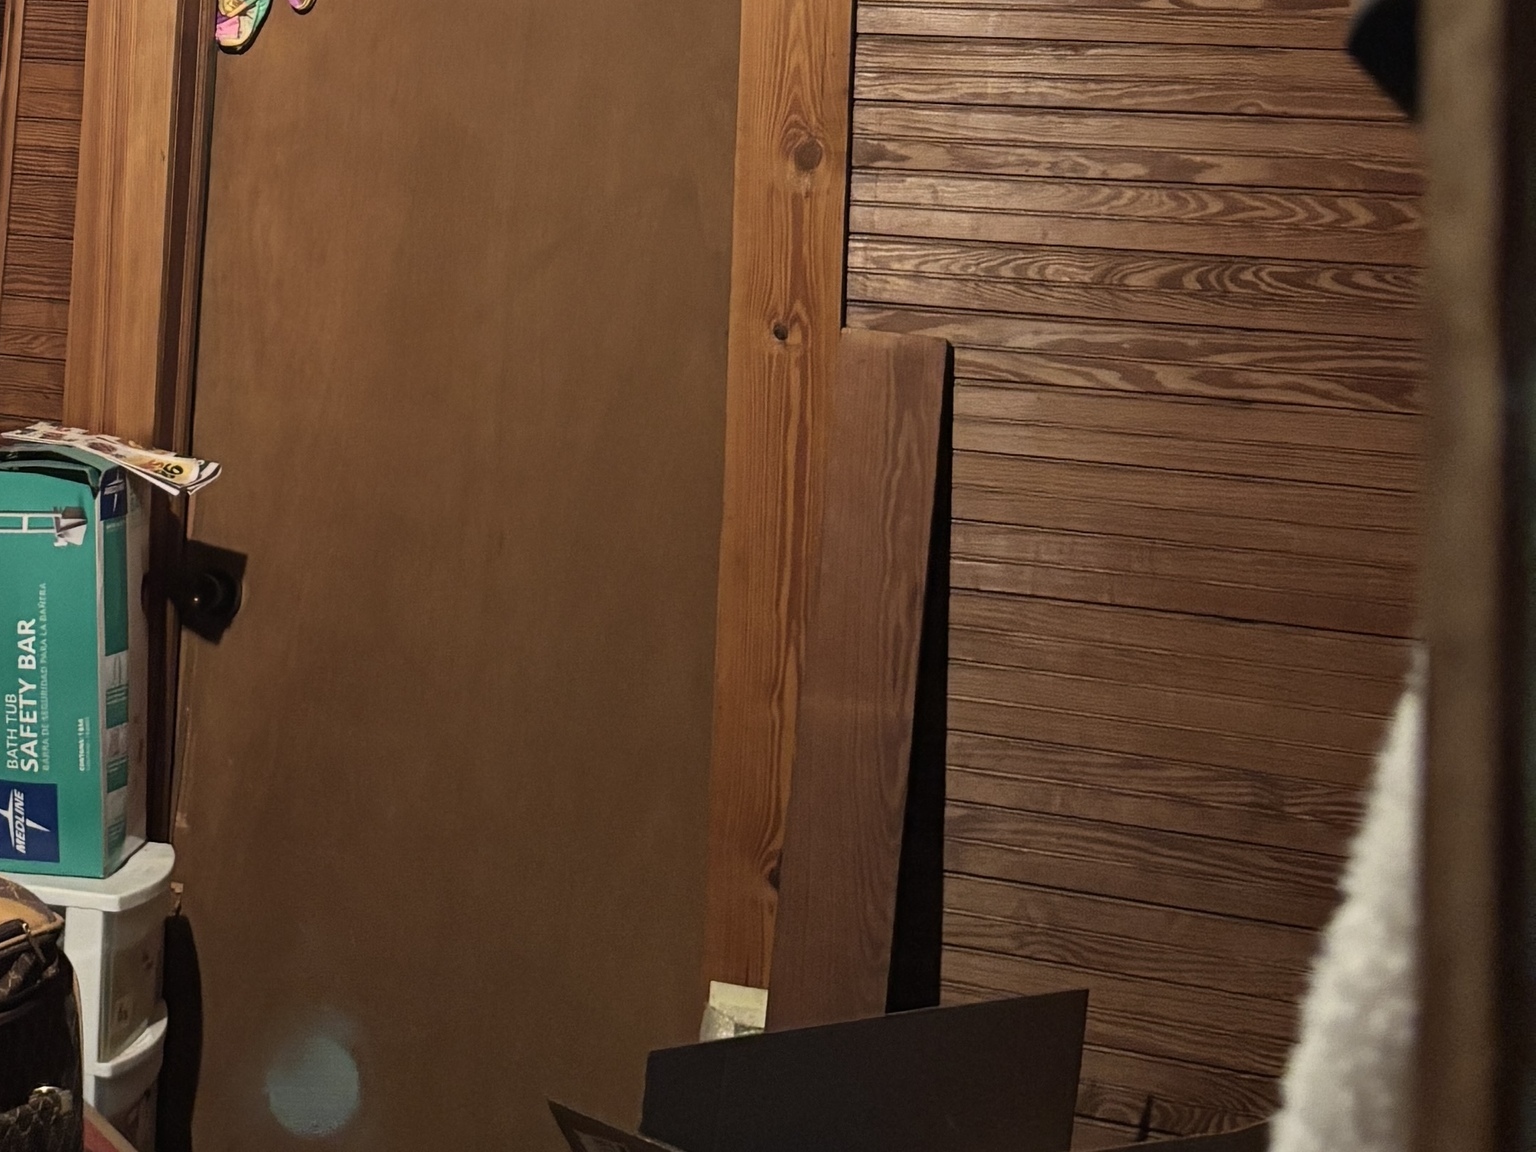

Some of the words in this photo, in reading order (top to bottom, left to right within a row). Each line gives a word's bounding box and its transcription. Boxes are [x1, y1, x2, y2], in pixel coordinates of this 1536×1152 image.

[17, 618, 37, 670] BAR
[39, 623, 47, 636] LA
[39, 638, 48, 664] PARA
[5, 693, 18, 724] TUB
[18, 677, 39, 773] SAFETY
[41, 723, 50, 737] DE
[6, 728, 19, 770] BATH
[42, 738, 50, 771] BARRA
[13, 788, 26, 855] MEDLINE
